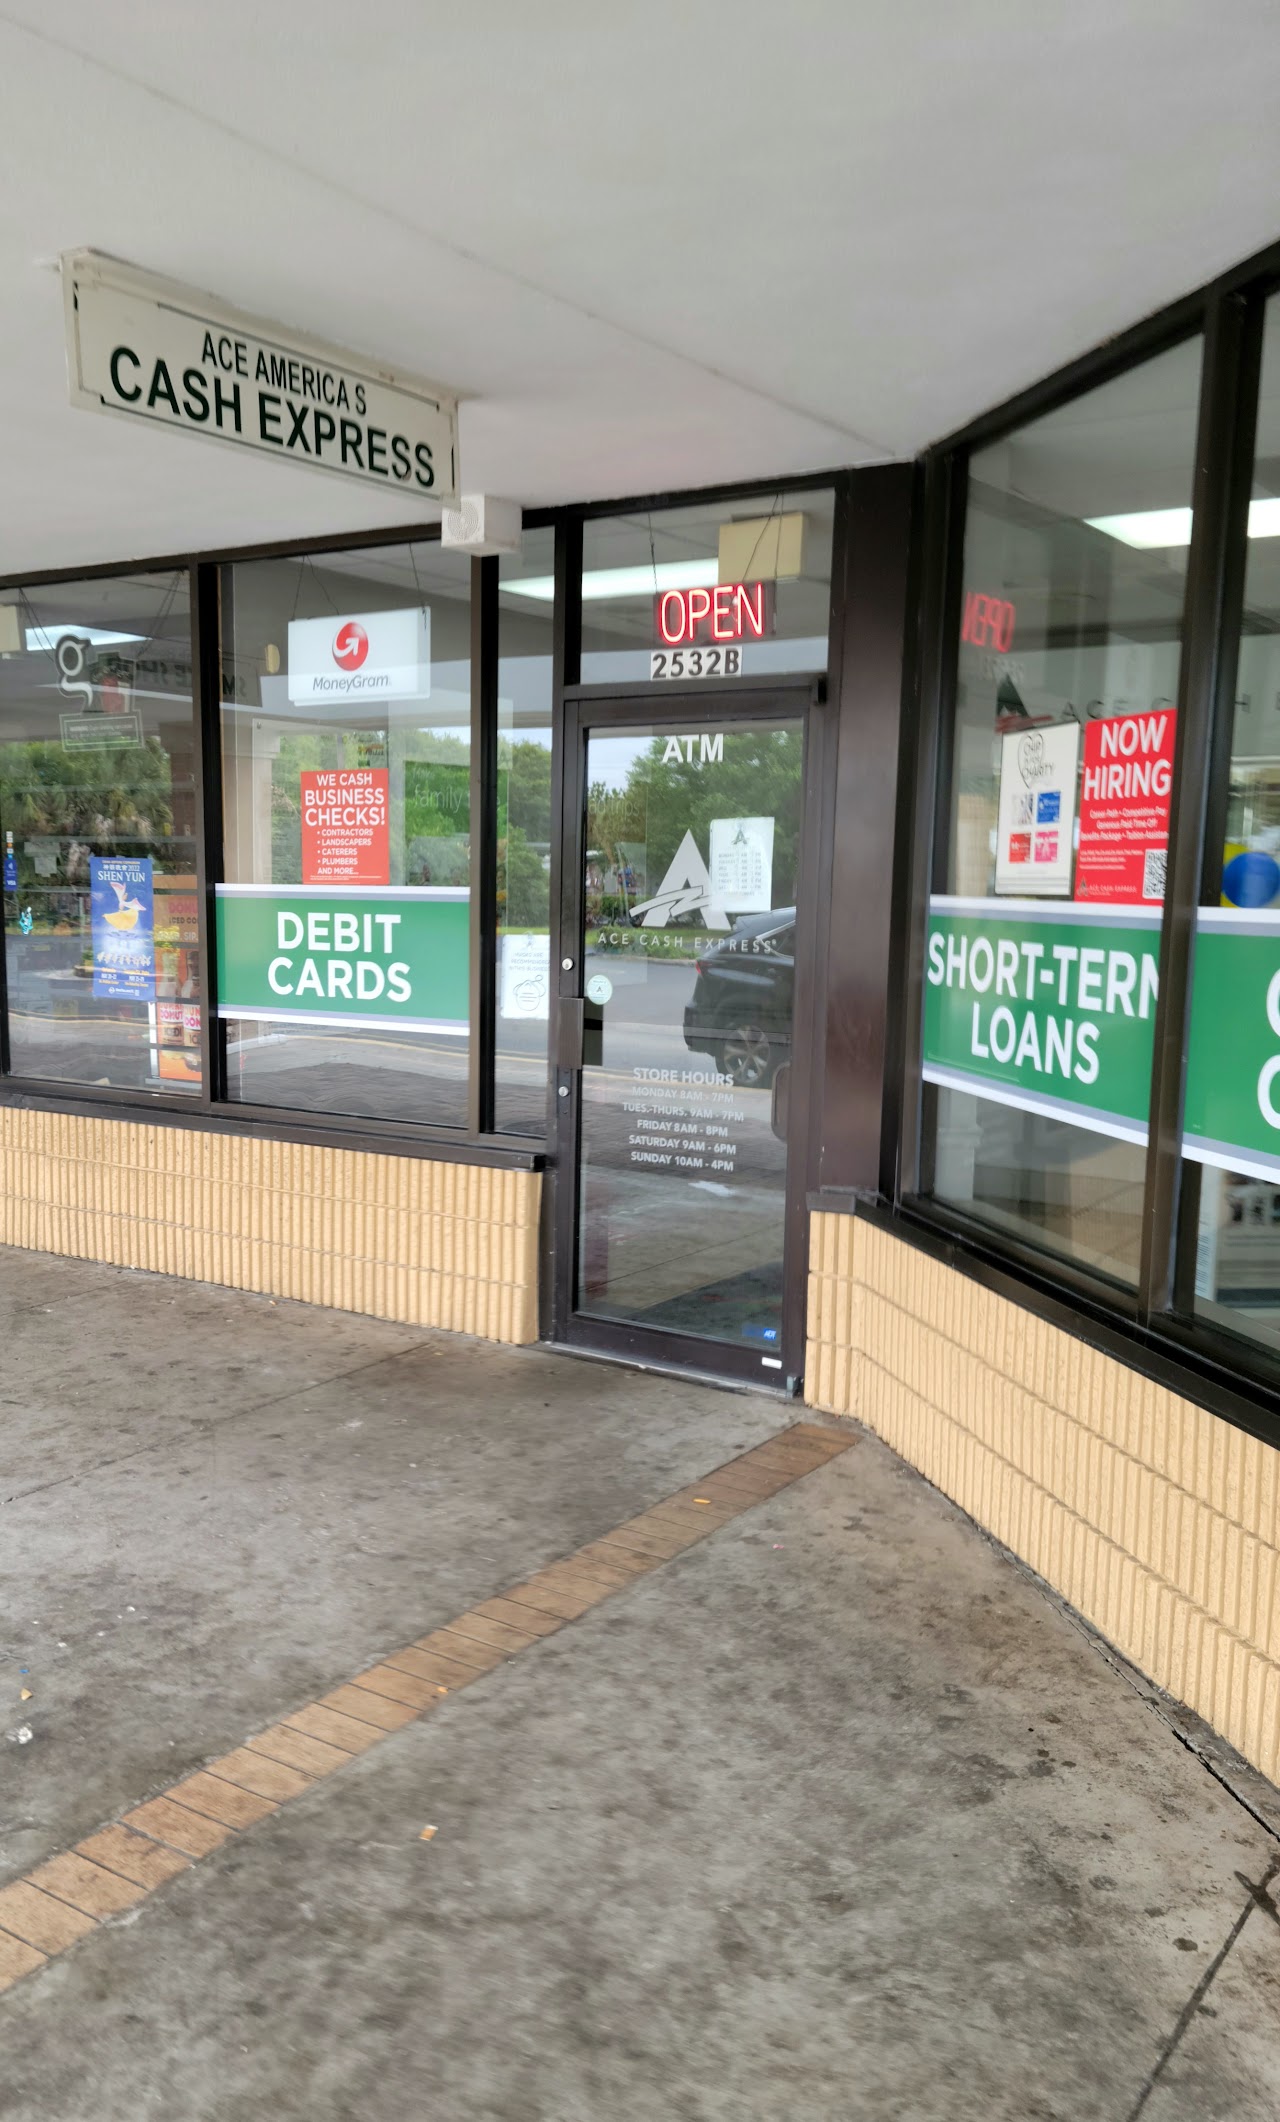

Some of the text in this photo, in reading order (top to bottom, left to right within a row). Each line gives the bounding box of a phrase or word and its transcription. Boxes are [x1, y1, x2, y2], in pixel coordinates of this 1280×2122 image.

[201, 331, 248, 378] ACE
[110, 346, 436, 488] CASH EXPRESS
[660, 582, 763, 643] OPEN
[652, 649, 739, 678] 2532B
[312, 674, 389, 693] MoneyGram
[1101, 715, 1167, 758] NOW
[662, 733, 723, 763] ATM
[316, 773, 372, 786] WE CASH
[1083, 759, 1171, 800] HIRING
[305, 788, 384, 806] BUSINESS
[305, 807, 385, 826] CHECKS!
[97, 871, 145, 882] SHEN YUN
[277, 911, 401, 954] DEBIT
[598, 933, 629, 944] ACE
[640, 935, 683, 947] CASH
[268, 957, 412, 1003] CARDS
[972, 1001, 1100, 1084] LOANS
[633, 1067, 734, 1086] STORE HOURS
[632, 1086, 676, 1098] MONDAY
[690, 1107, 713, 1119] 9AM
[637, 1119, 673, 1131] FRIDAY
[674, 1122, 697, 1134] 8AM
[706, 1125, 728, 1137] 8PM
[629, 1135, 680, 1148] SATURDAY
[682, 1139, 705, 1152] 9AM
[714, 1144, 736, 1155] 6PM
[631, 1151, 672, 1164] SUNDAY
[675, 1155, 703, 1167] 10AM
[711, 1159, 734, 1172] 4PM
